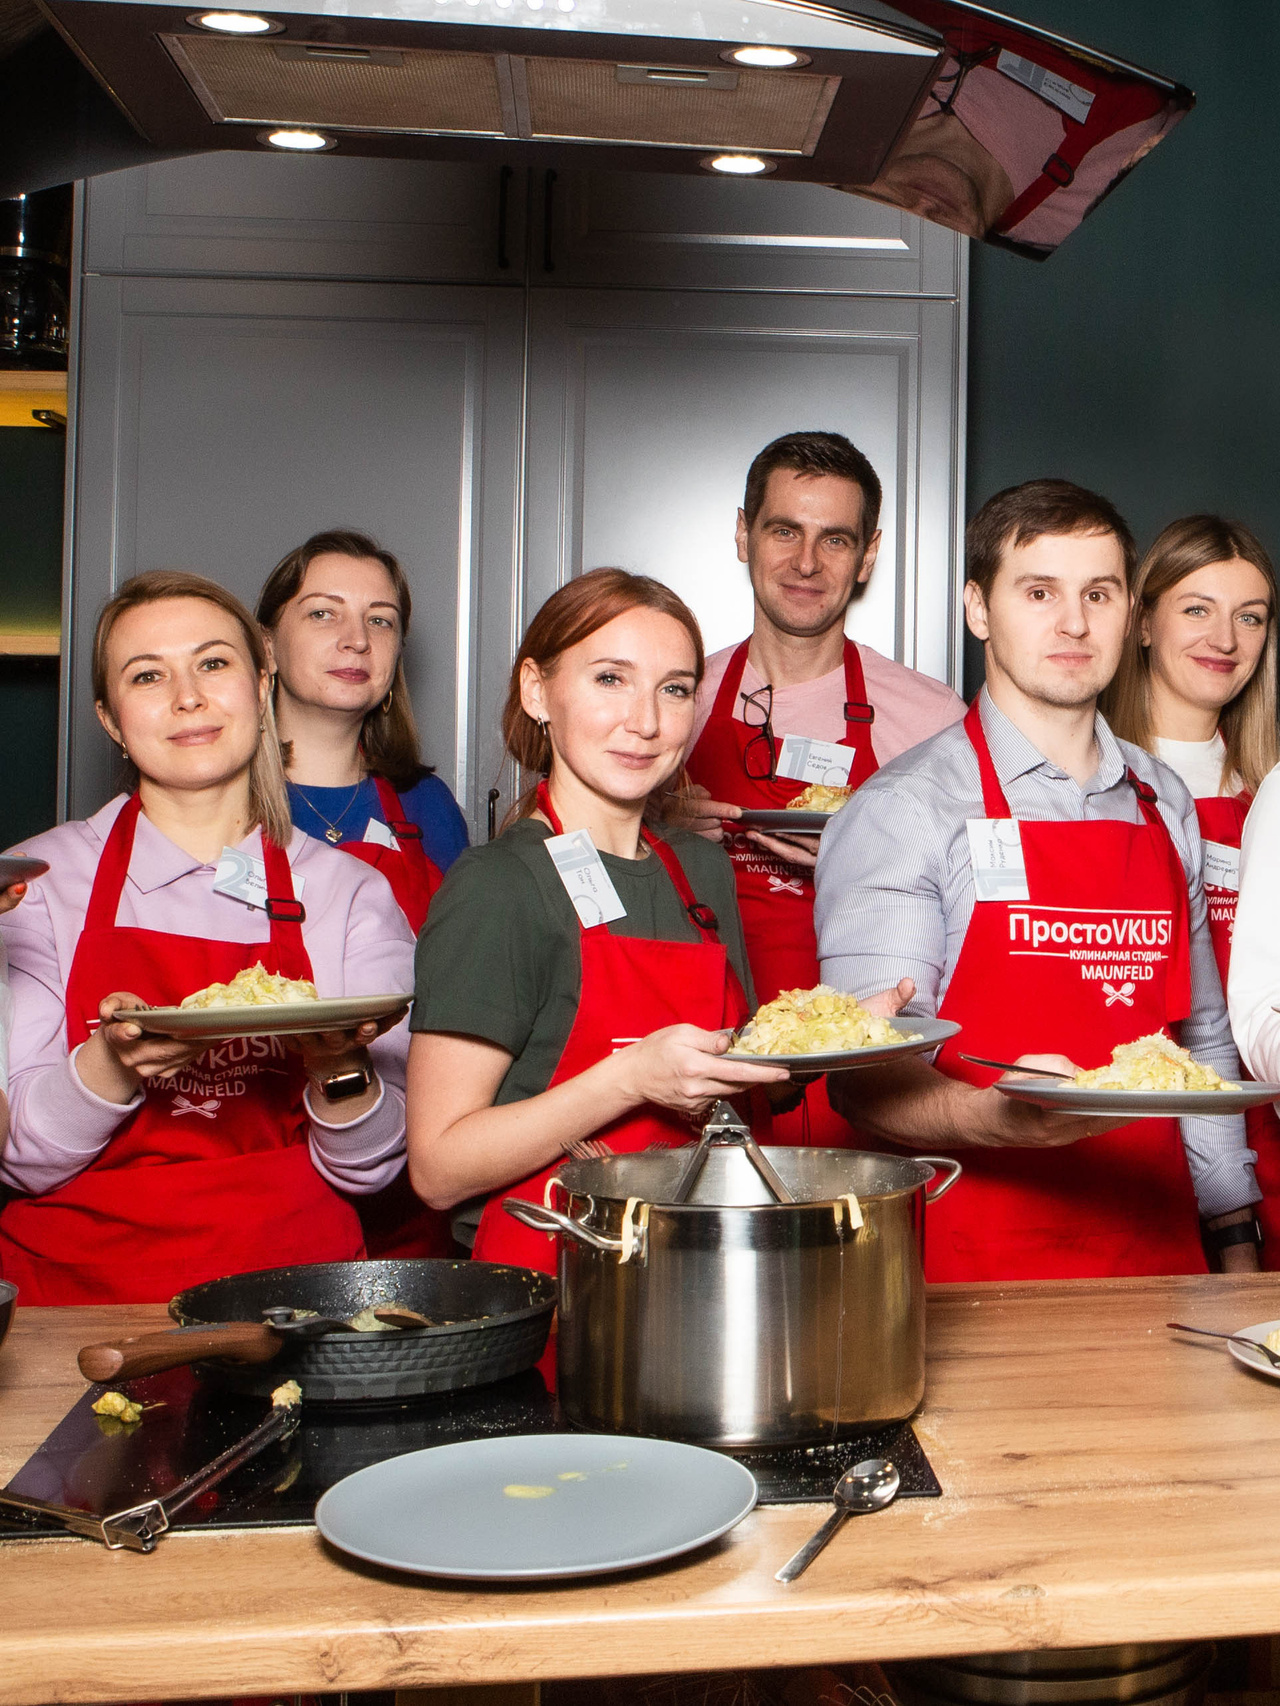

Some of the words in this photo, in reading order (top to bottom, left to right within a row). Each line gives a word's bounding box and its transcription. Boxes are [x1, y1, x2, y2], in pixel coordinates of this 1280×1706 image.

[1069, 950, 1130, 961] КУЛИНАРНАЯ
[1081, 965, 1154, 980] MAUNFELD
[214, 1065, 258, 1081] СТУДИЯ
[147, 1076, 247, 1097] MAUNFELD
